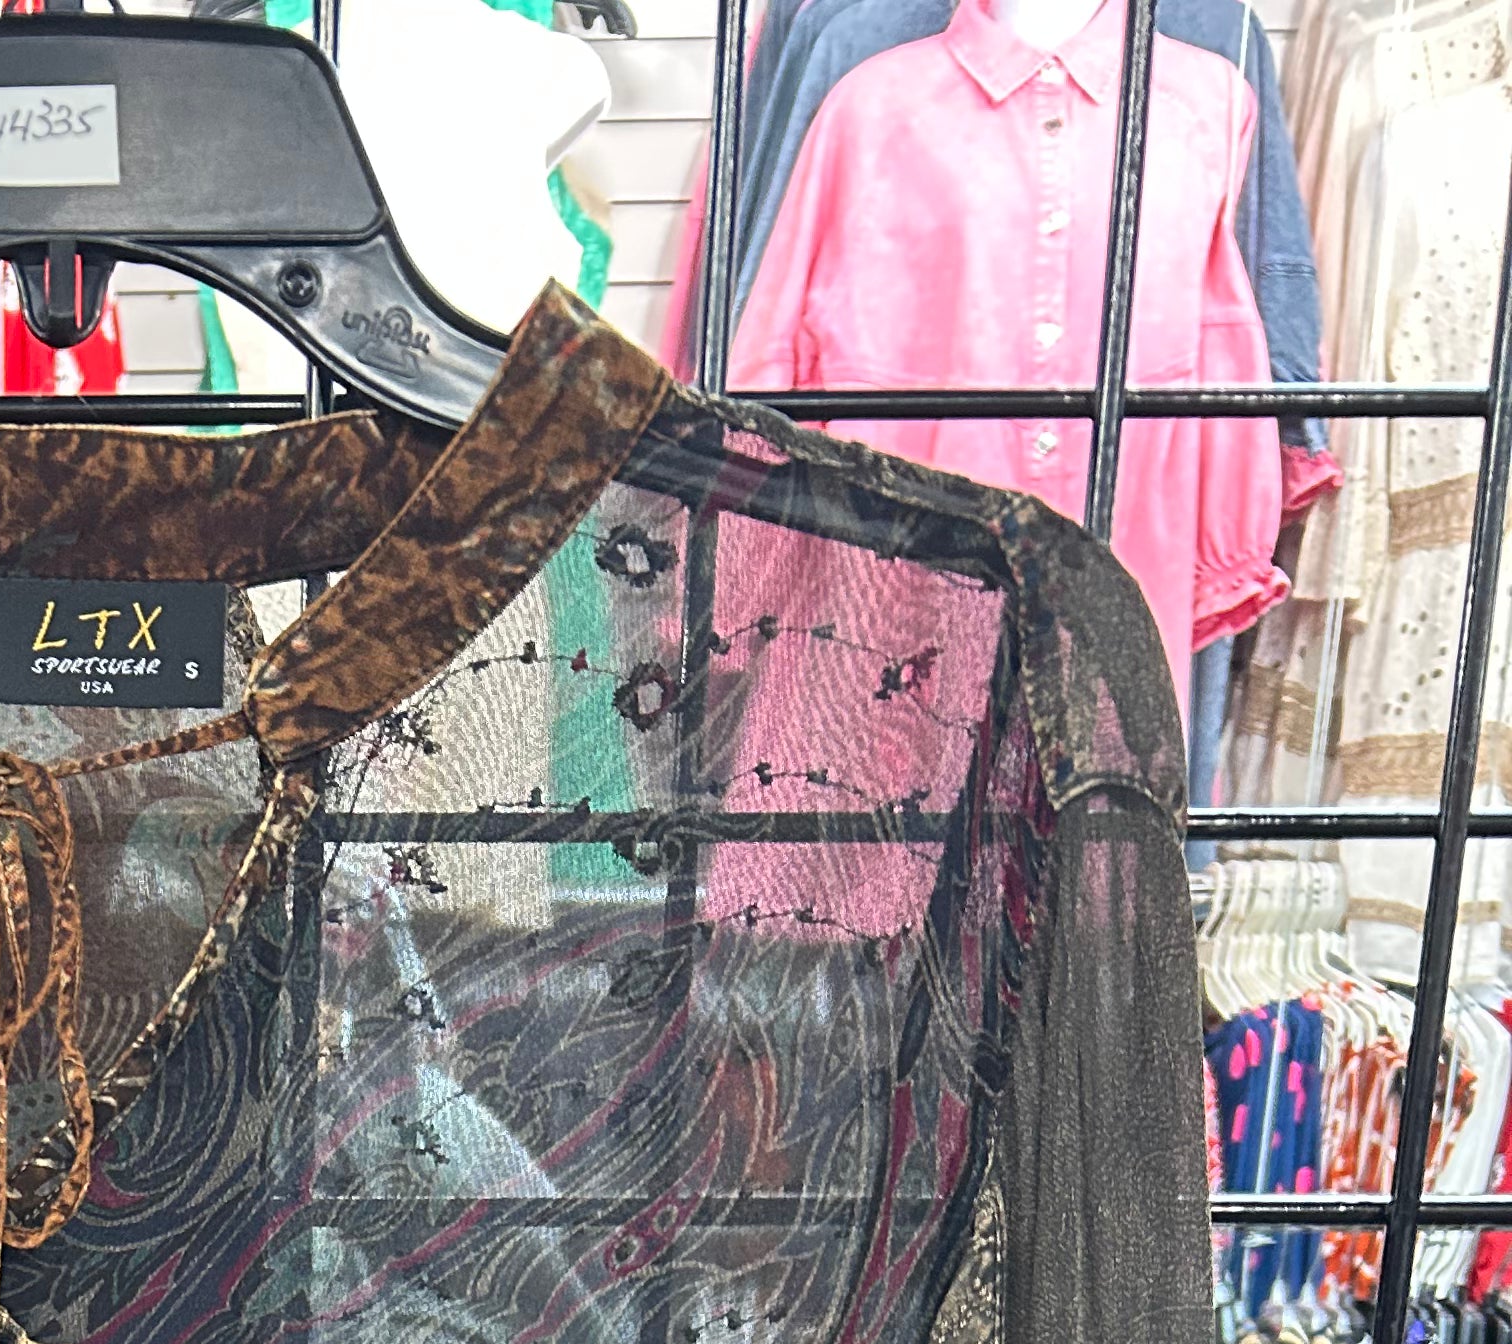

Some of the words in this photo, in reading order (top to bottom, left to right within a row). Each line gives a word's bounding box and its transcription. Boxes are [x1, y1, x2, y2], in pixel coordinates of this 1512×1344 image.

[32, 600, 163, 652] LTX
[31, 657, 162, 676] SPORTSWEAR
[183, 661, 200, 680] S
[80, 681, 115, 694] USA
